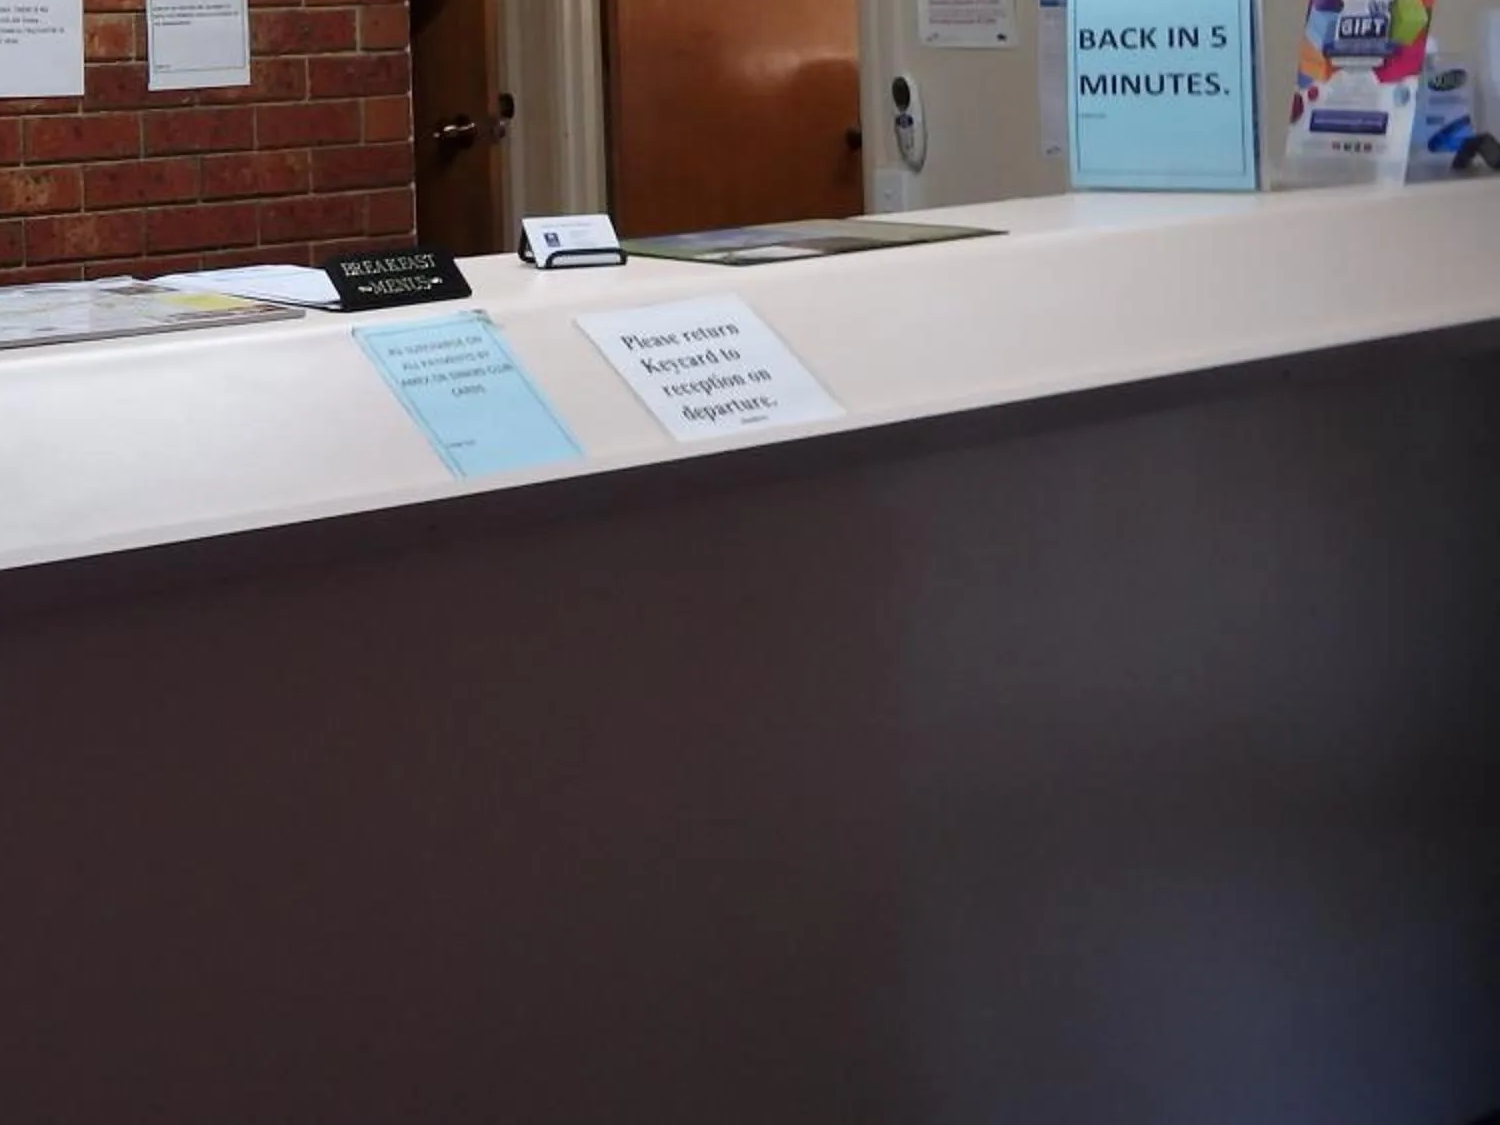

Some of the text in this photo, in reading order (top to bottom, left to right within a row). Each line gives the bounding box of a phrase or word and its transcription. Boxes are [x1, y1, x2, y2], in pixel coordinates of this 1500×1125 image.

[1078, 25, 1227, 51] BACK IN 5
[1341, 17, 1385, 36] GIFT
[1079, 72, 1230, 97] MINUTES.
[340, 254, 436, 277] BREAKFAST
[370, 276, 433, 295] MENUS
[620, 322, 740, 351] Please return
[640, 347, 741, 375] Keycard to
[662, 368, 773, 397] reception on
[681, 394, 779, 422] departure.
